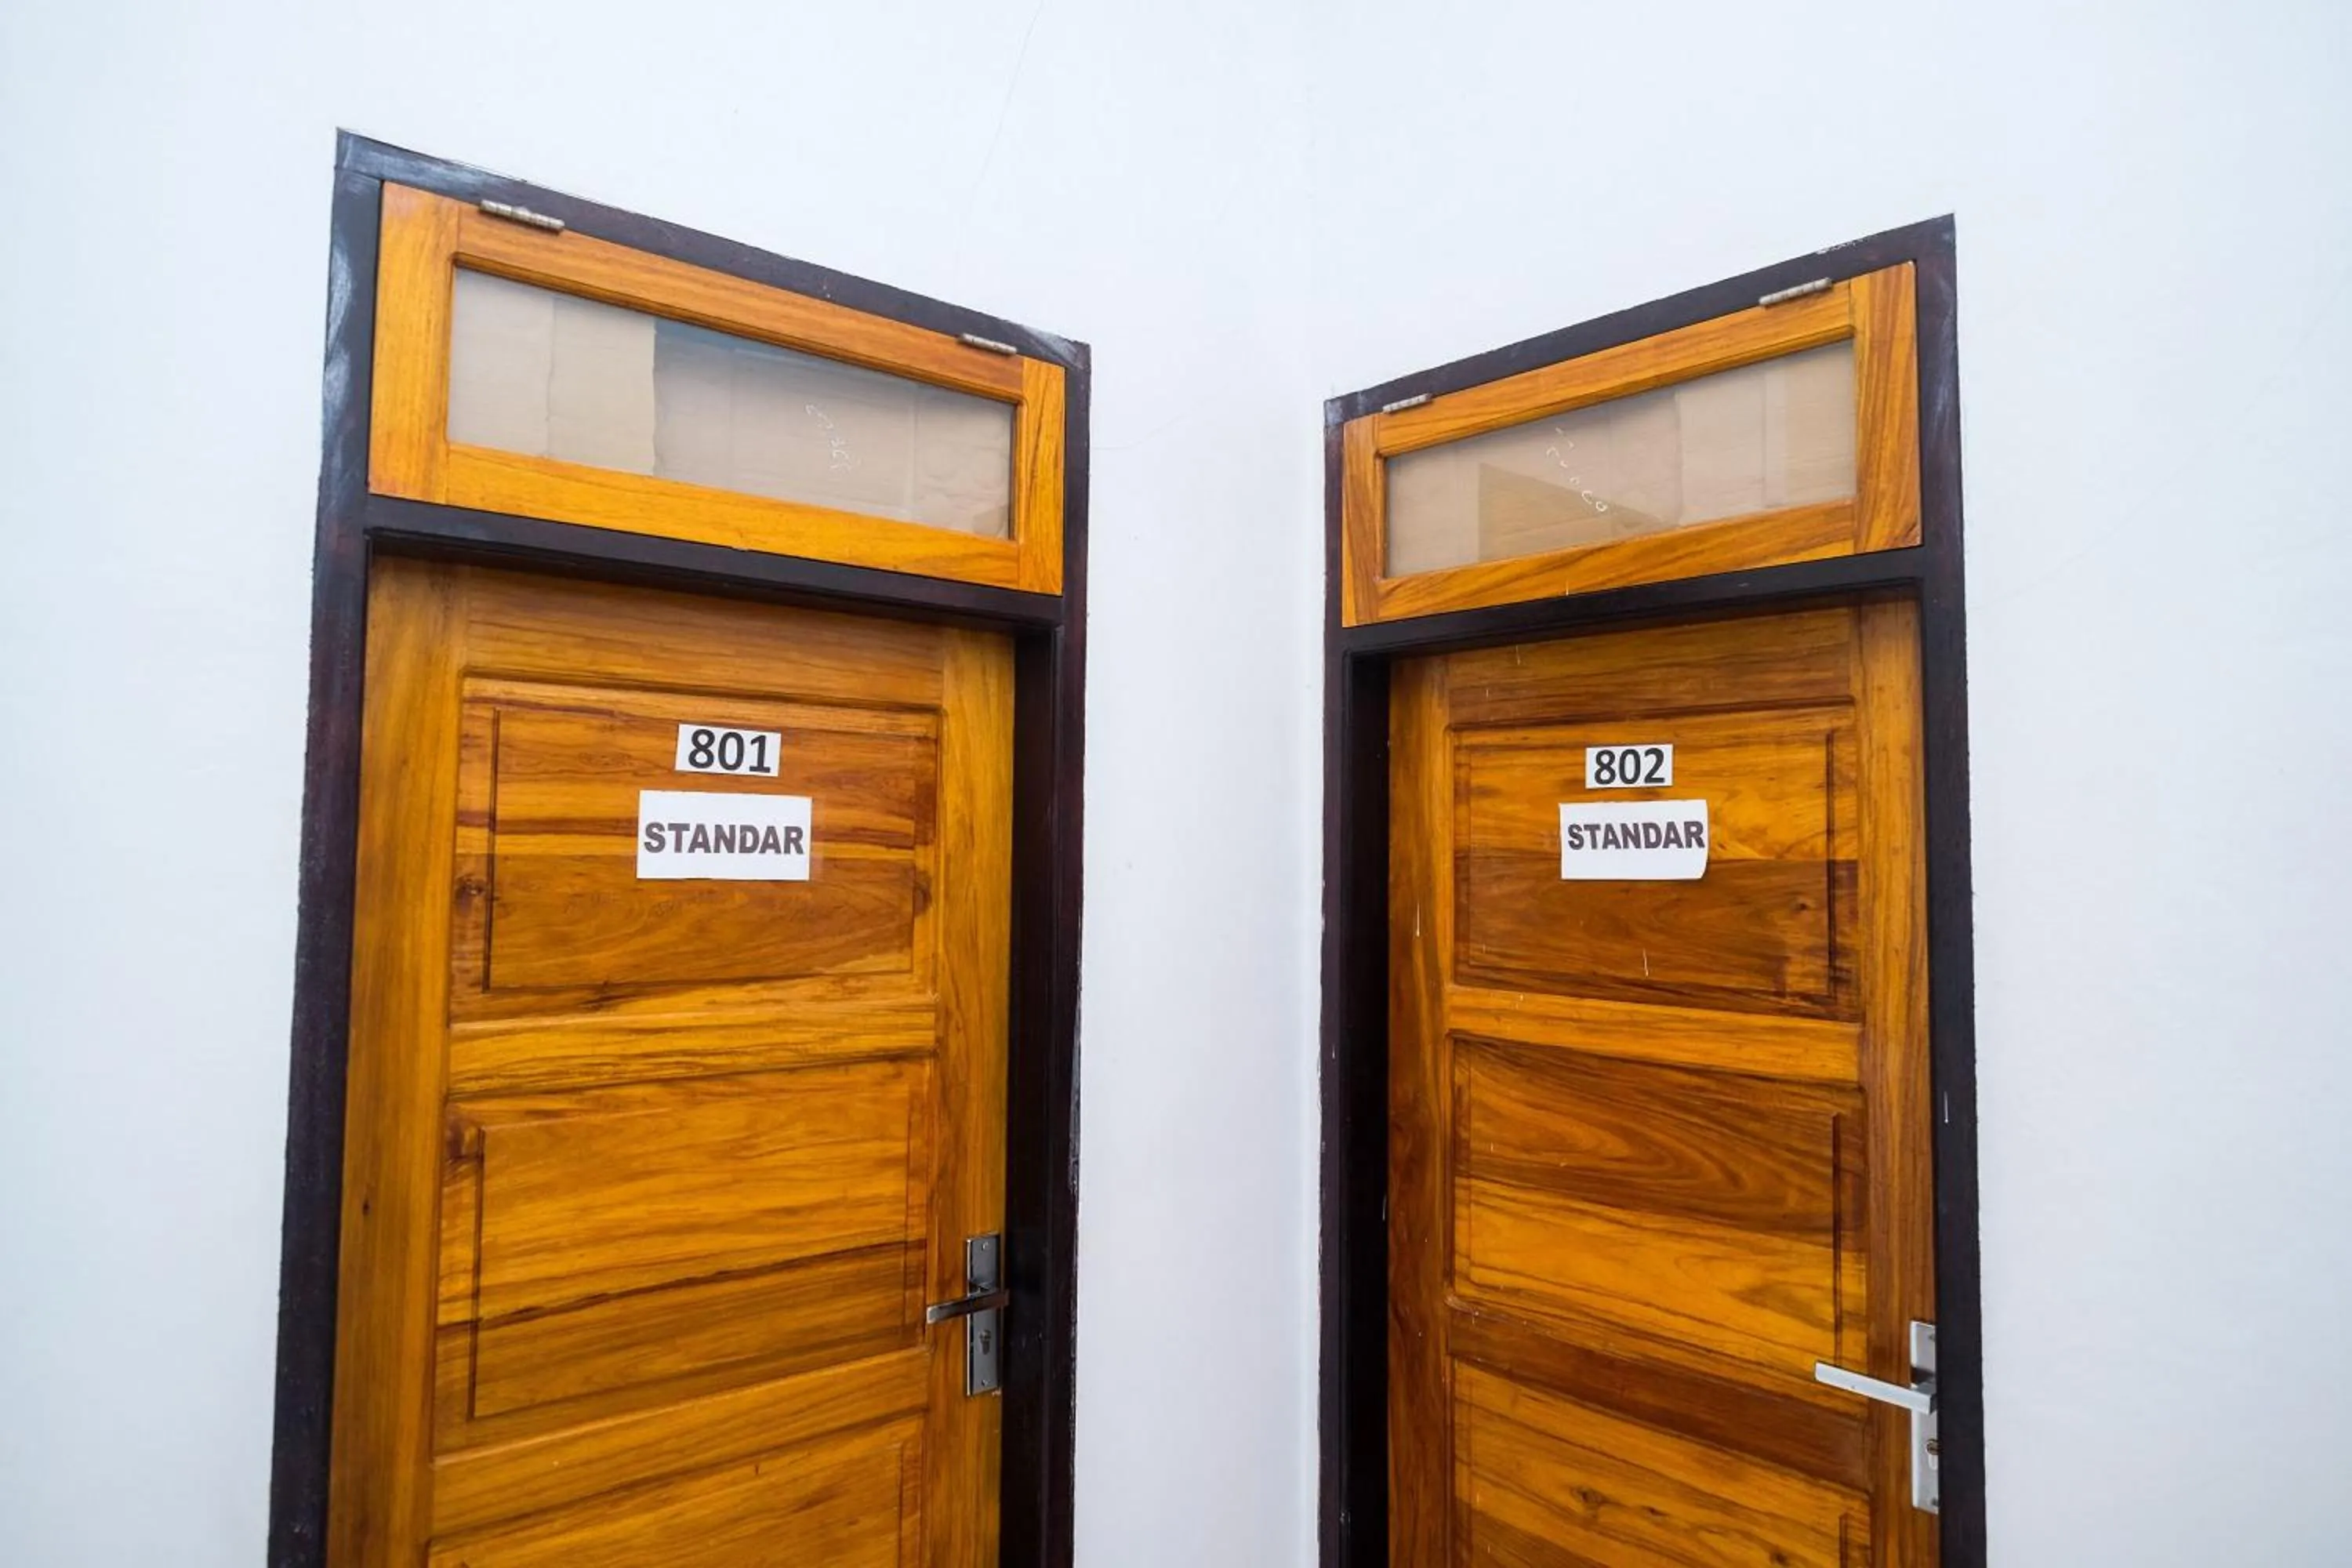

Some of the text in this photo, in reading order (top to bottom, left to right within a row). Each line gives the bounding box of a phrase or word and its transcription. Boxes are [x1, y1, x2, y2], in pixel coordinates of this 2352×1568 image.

[688, 729, 771, 773] 801
[1594, 748, 1665, 785] 802
[644, 822, 804, 855] STANDAR
[1568, 821, 1705, 850] STANDAR
